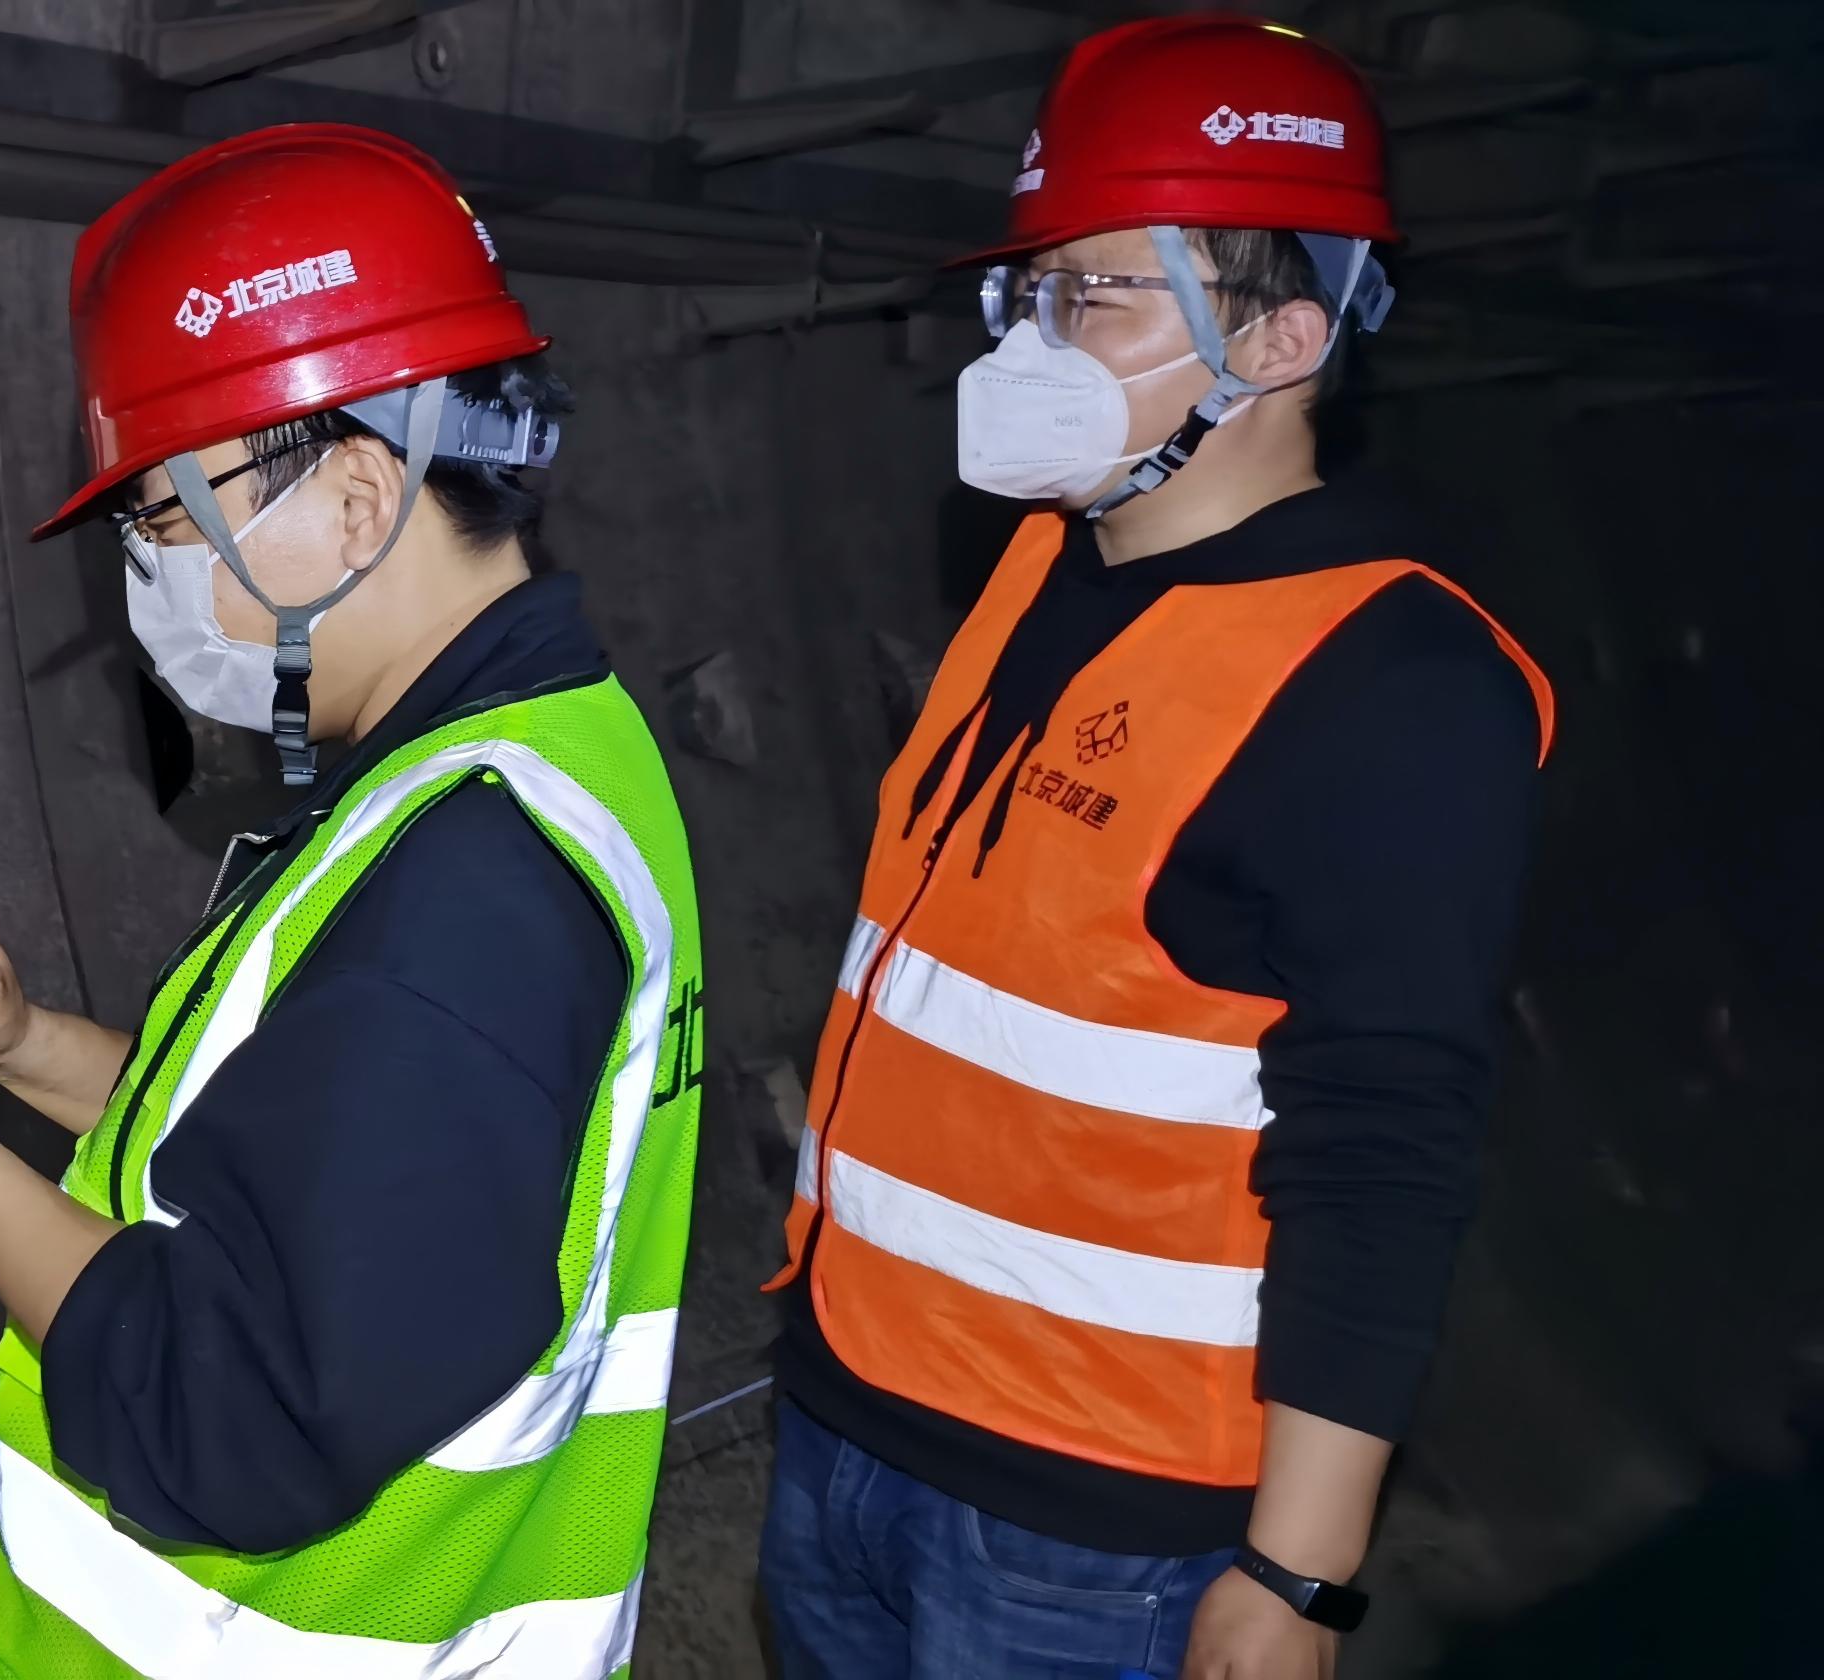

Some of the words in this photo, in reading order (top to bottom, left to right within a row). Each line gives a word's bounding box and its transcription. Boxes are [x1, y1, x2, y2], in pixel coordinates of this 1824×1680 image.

[1246, 112, 1345, 149] 北京城建
[222, 249, 358, 318] 北京城建
